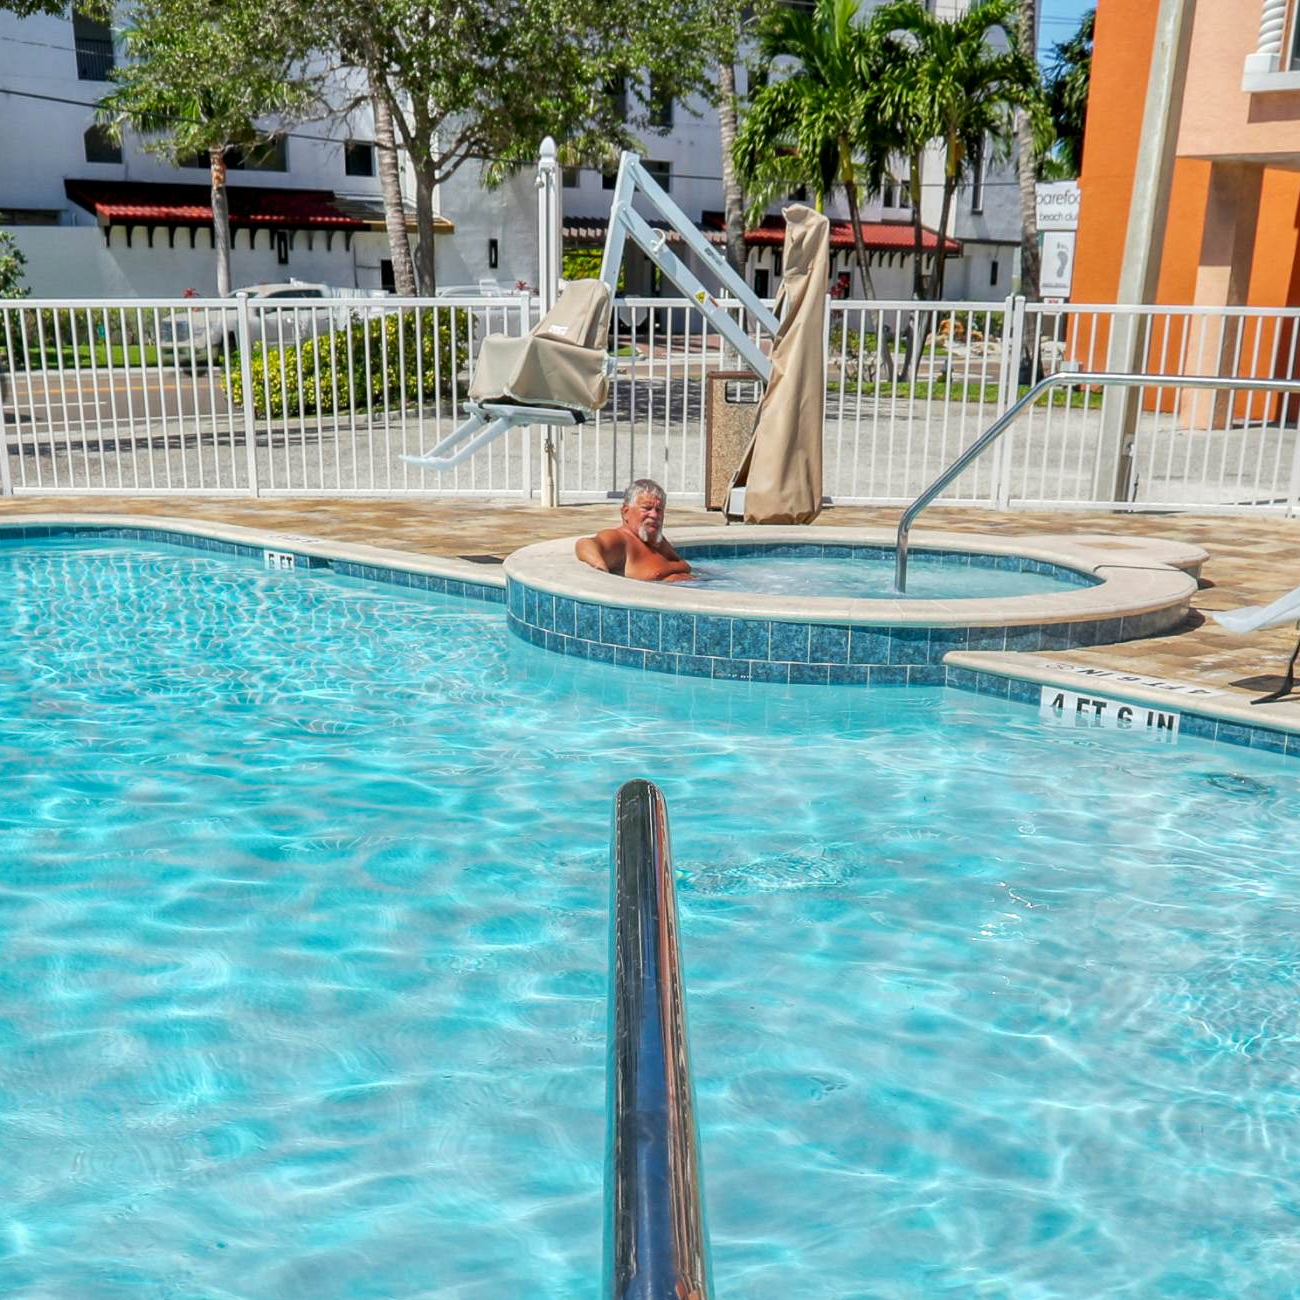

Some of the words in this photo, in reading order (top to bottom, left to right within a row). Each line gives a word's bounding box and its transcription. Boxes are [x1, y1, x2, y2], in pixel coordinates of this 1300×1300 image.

[1036, 188, 1080, 205] arefo
[1076, 697, 1107, 715] FT
[1147, 711, 1175, 731] IN
